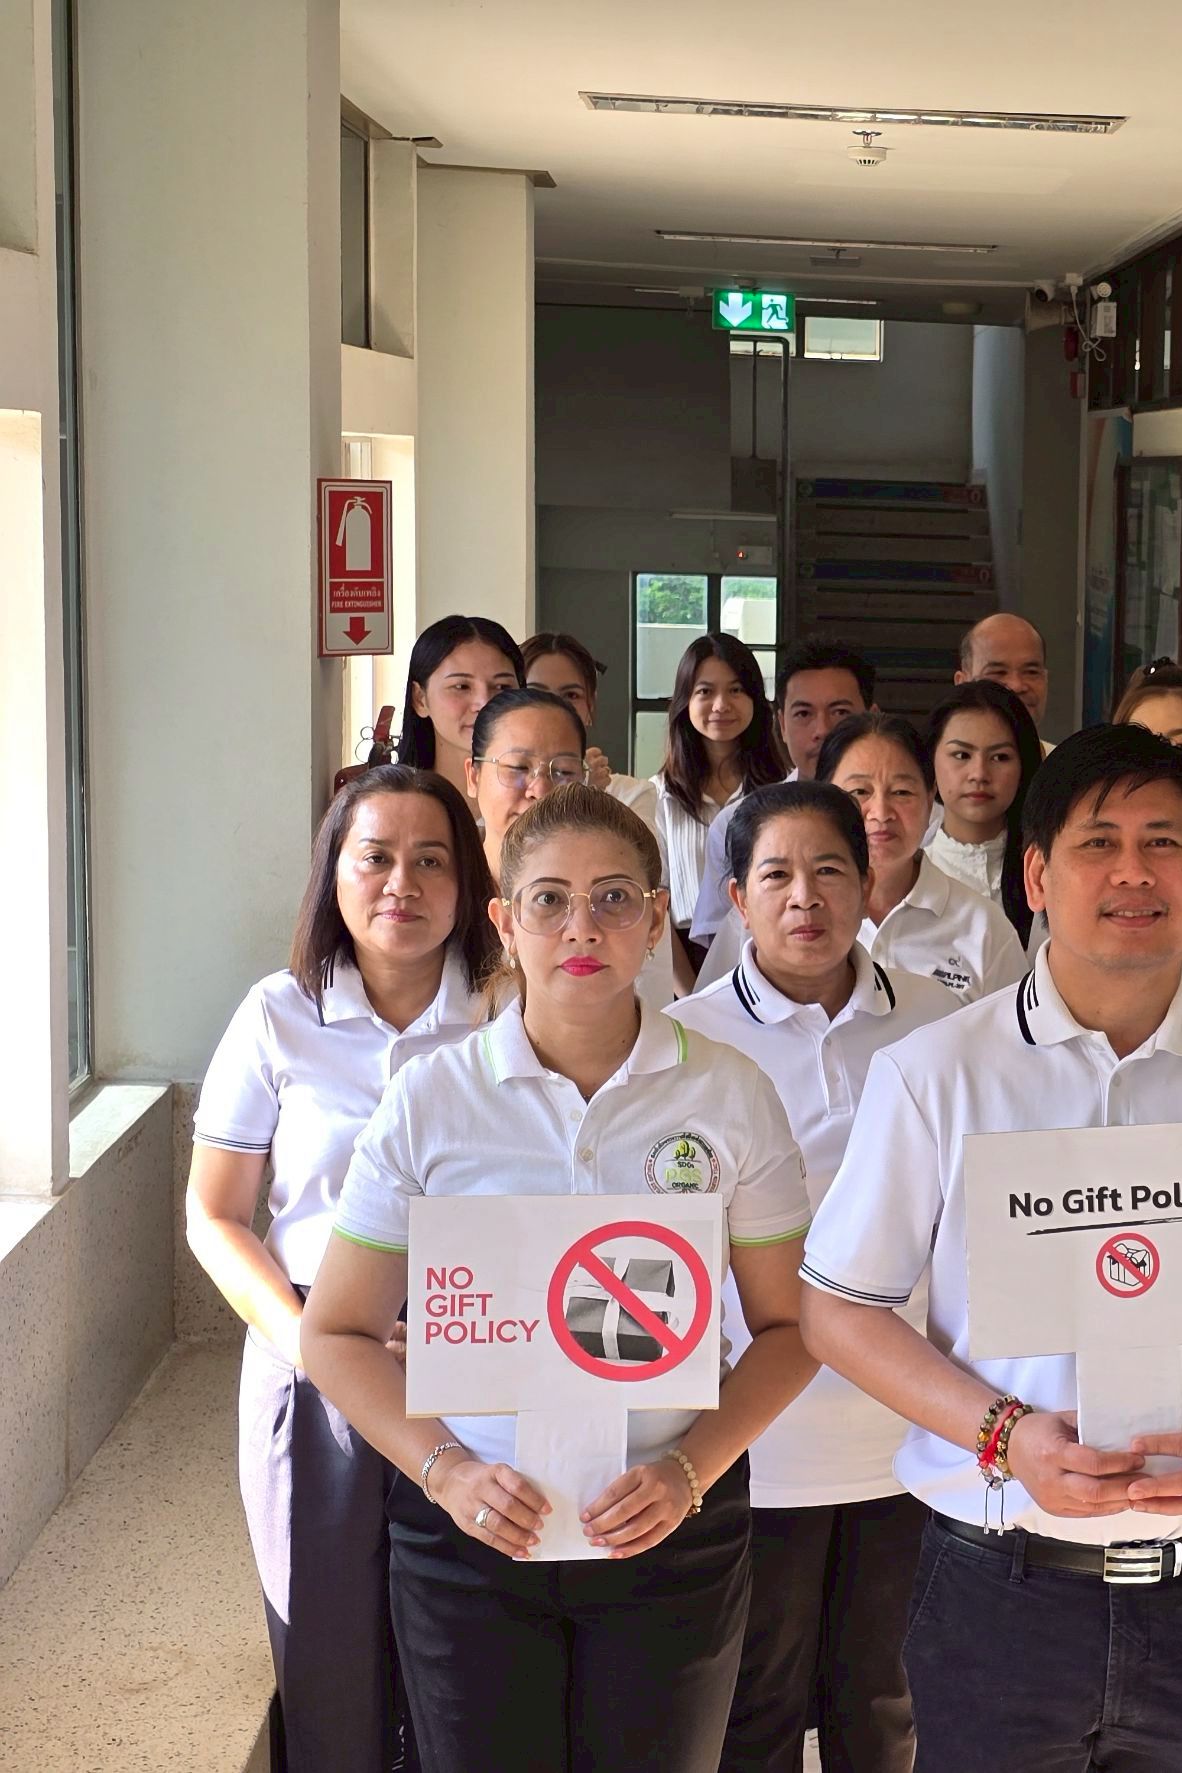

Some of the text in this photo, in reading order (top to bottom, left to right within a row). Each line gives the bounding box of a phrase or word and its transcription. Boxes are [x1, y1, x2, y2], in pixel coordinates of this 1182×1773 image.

[333, 583, 381, 598] เครื่องดับเพลิง
[331, 600, 344, 608] FIRE
[1009, 1192, 1053, 1218] No
[1062, 1186, 1123, 1214] Gift
[426, 1266, 474, 1290] NO
[425, 1293, 493, 1318] GIFT
[425, 1319, 540, 1345] POLICY
